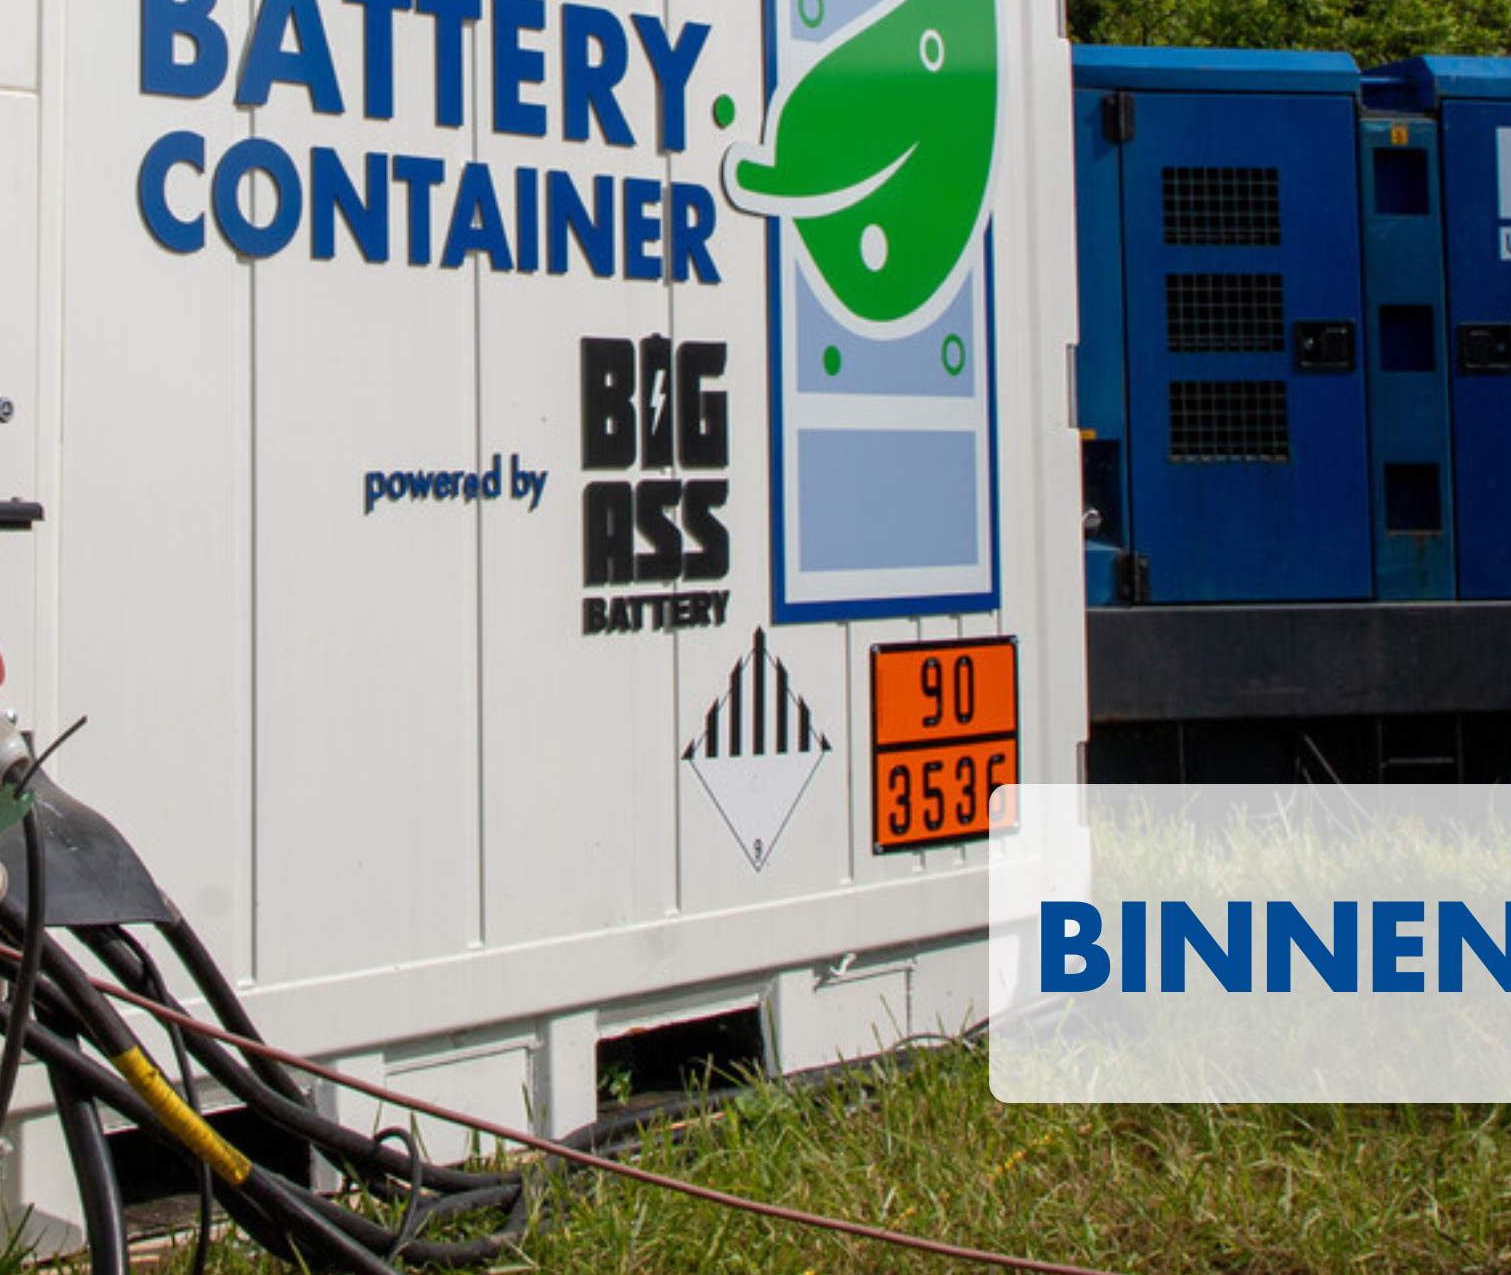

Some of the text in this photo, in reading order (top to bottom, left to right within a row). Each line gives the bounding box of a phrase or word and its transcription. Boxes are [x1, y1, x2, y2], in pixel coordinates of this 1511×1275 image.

[137, 130, 721, 284] CONTAINER
[580, 332, 729, 471] BIG
[364, 453, 548, 516] powered by
[581, 478, 730, 588] ASS
[582, 590, 730, 635] BATTERY
[921, 655, 974, 728] 90
[888, 753, 1006, 836] 3536
